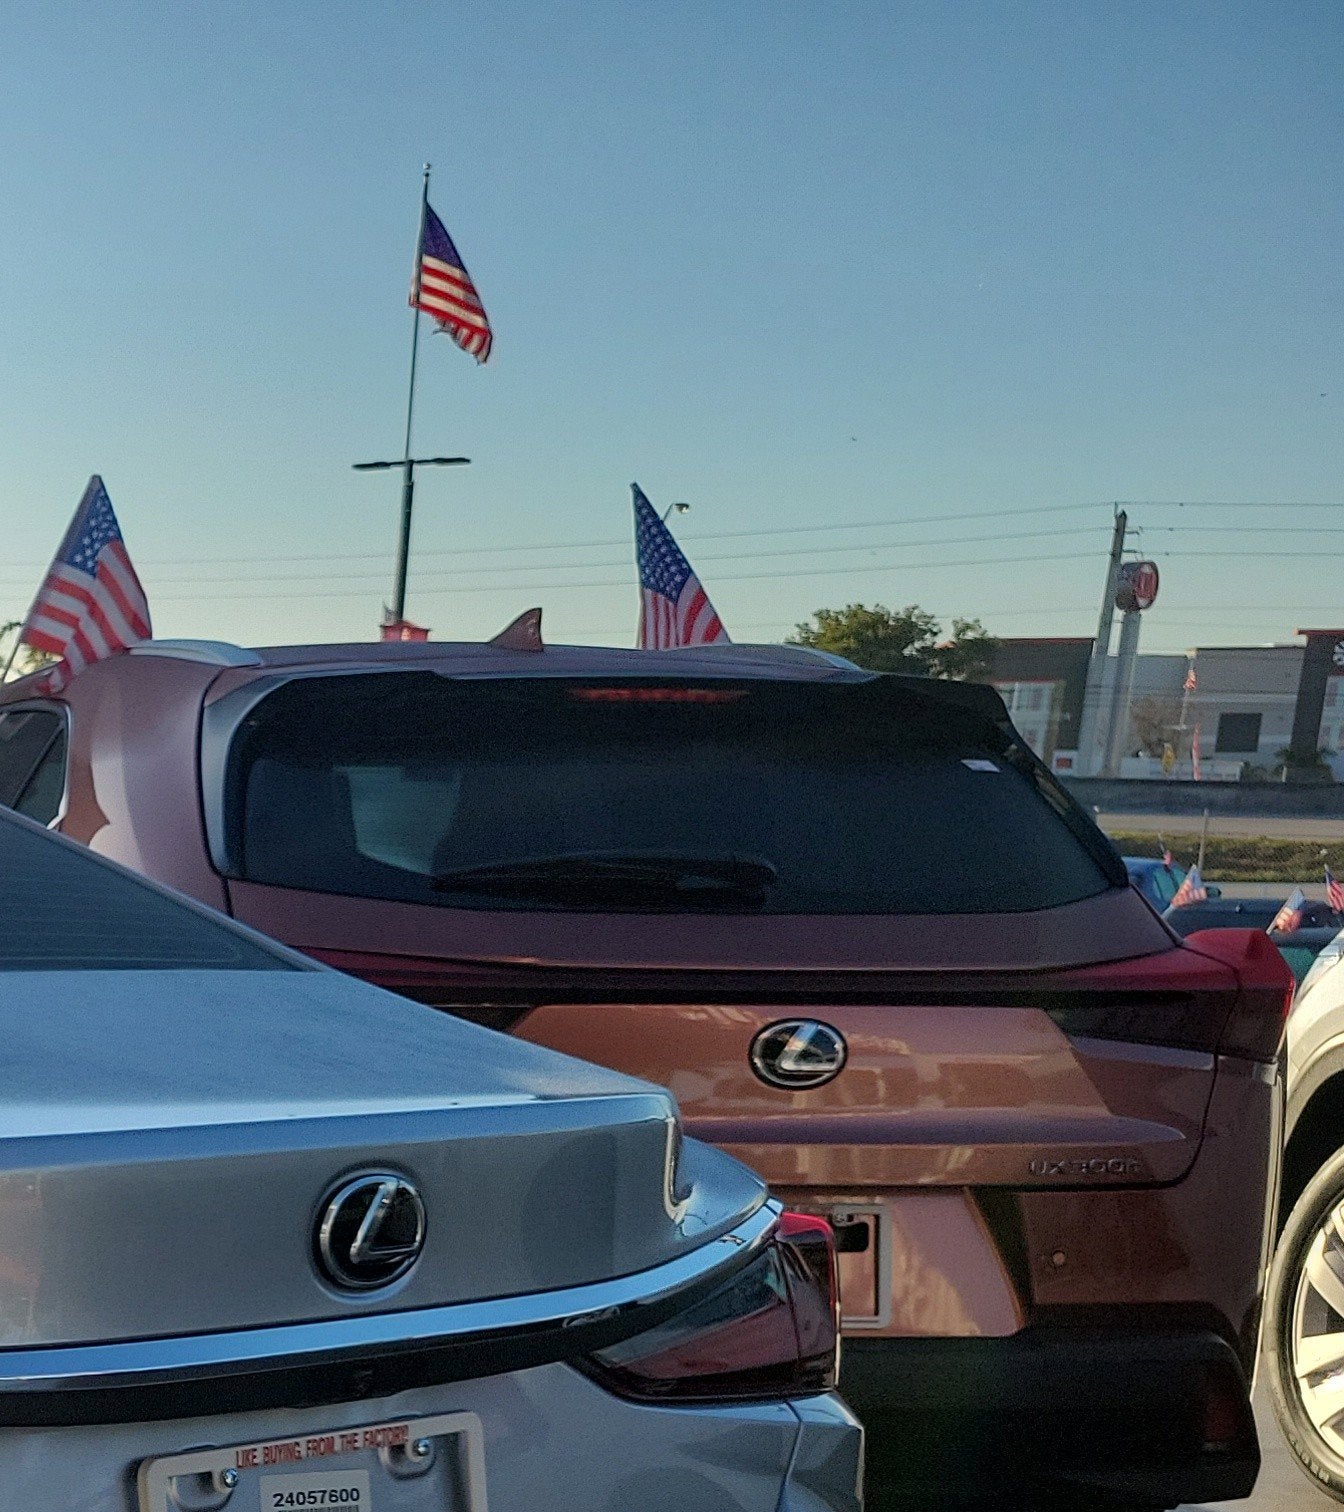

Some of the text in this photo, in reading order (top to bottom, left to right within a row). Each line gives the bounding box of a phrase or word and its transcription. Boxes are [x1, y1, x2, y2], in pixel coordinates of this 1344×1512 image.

[236, 1448, 259, 1468] LIKE
[263, 1442, 303, 1464] BUYING
[307, 1436, 335, 1457] FROM
[339, 1432, 359, 1451] THE
[273, 1488, 360, 1507] 24057600
